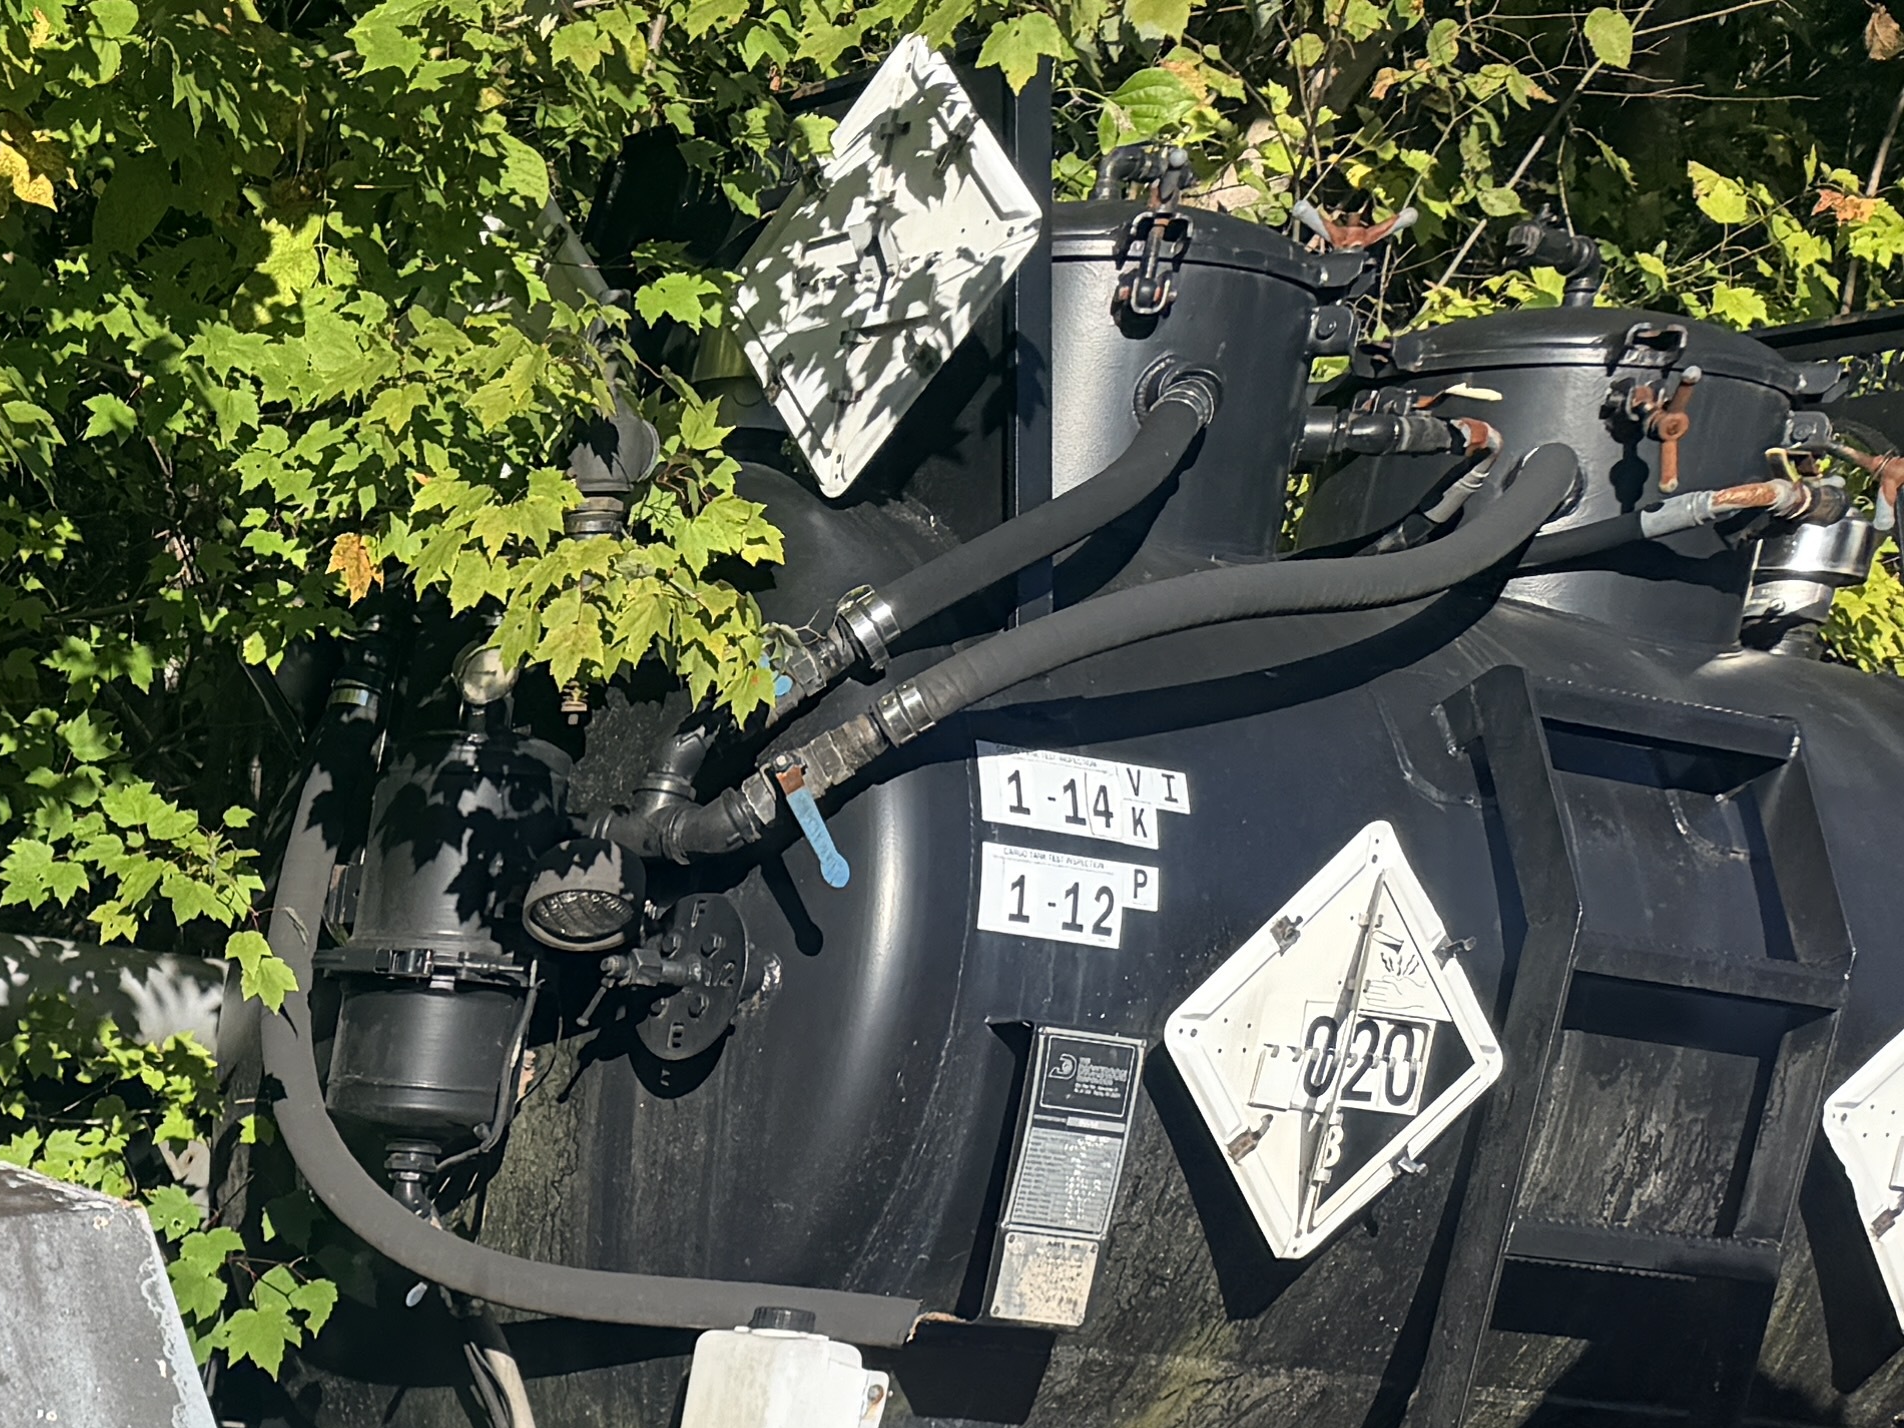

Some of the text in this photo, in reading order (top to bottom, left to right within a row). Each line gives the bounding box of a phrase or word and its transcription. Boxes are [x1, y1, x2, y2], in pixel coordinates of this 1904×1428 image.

[1126, 767, 1141, 797] V
[1131, 806, 1148, 838] K
[1133, 868, 1148, 900] P
